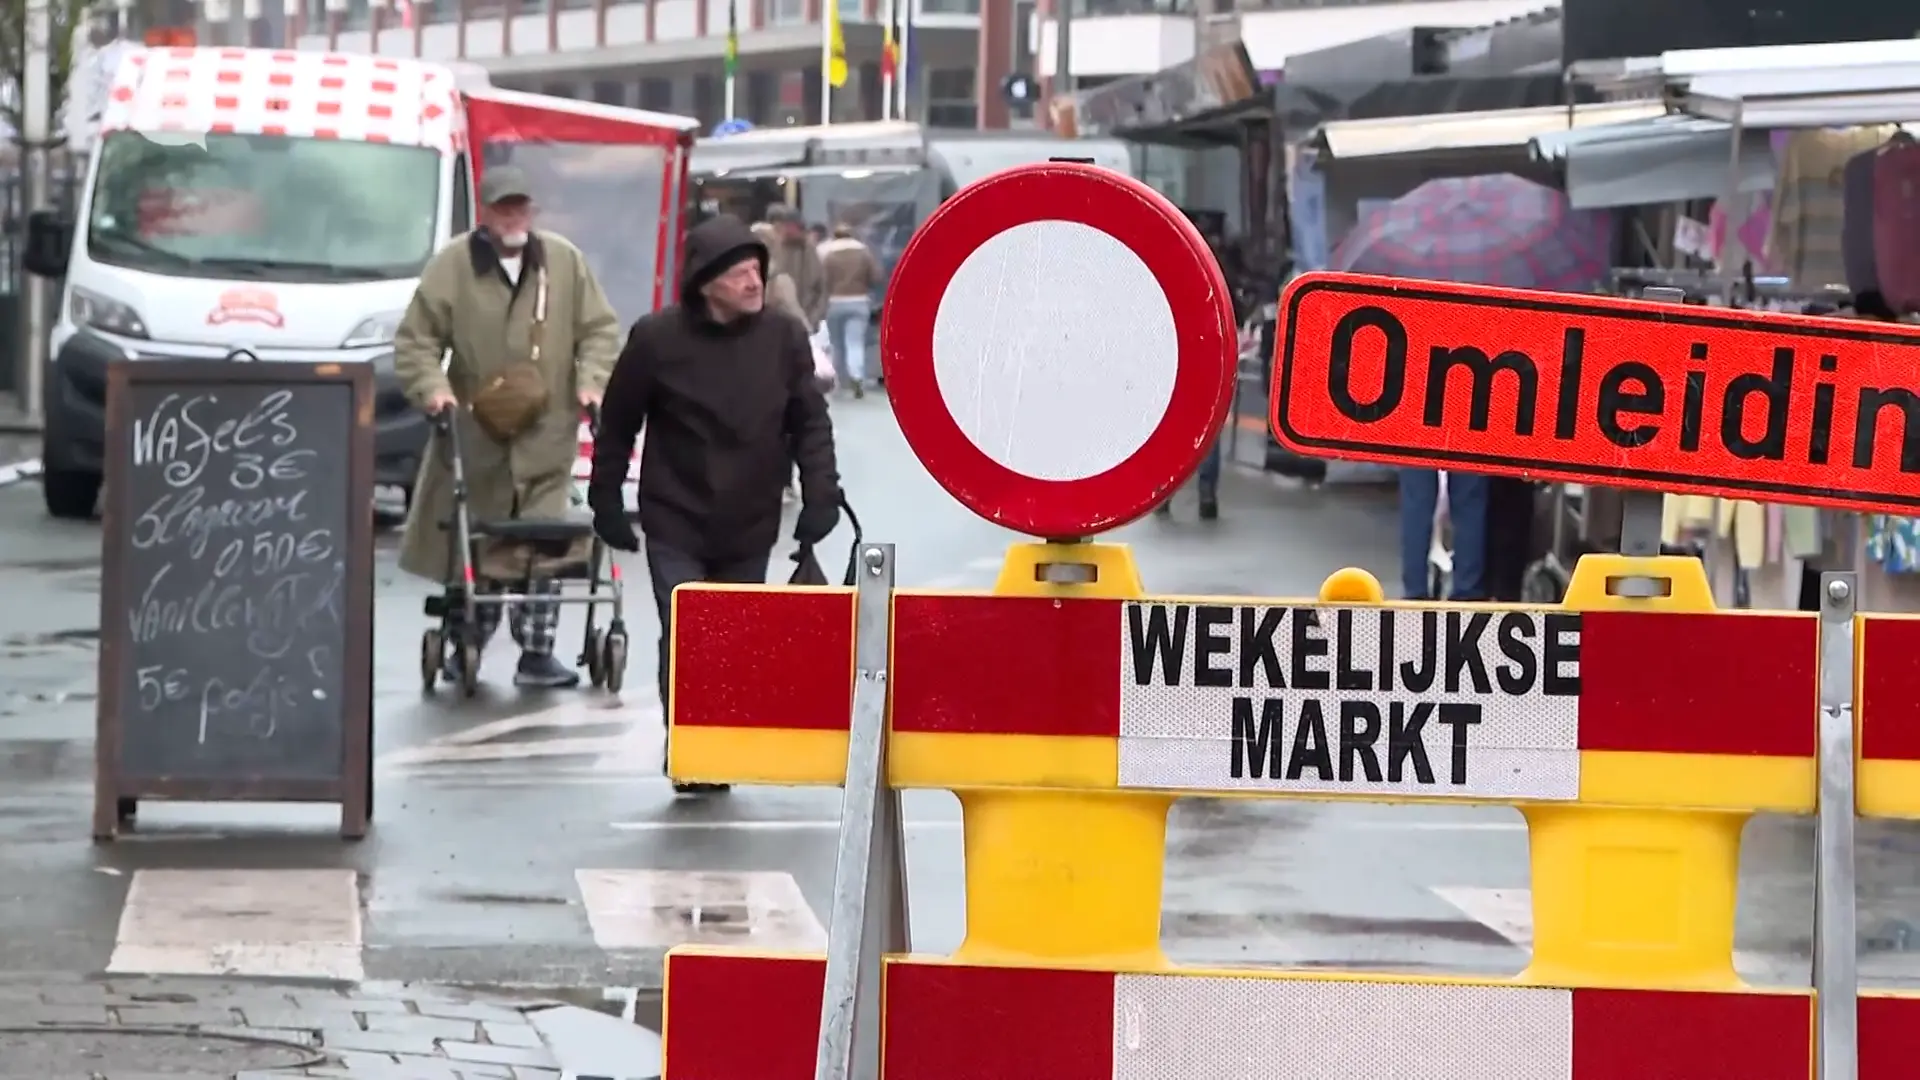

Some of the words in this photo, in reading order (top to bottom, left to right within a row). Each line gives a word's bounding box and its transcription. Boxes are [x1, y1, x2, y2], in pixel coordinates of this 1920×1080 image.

[1327, 307, 1920, 473] Omleidin
[1127, 604, 1582, 697] WEKELIJKSE
[1230, 697, 1481, 785] MARKT
